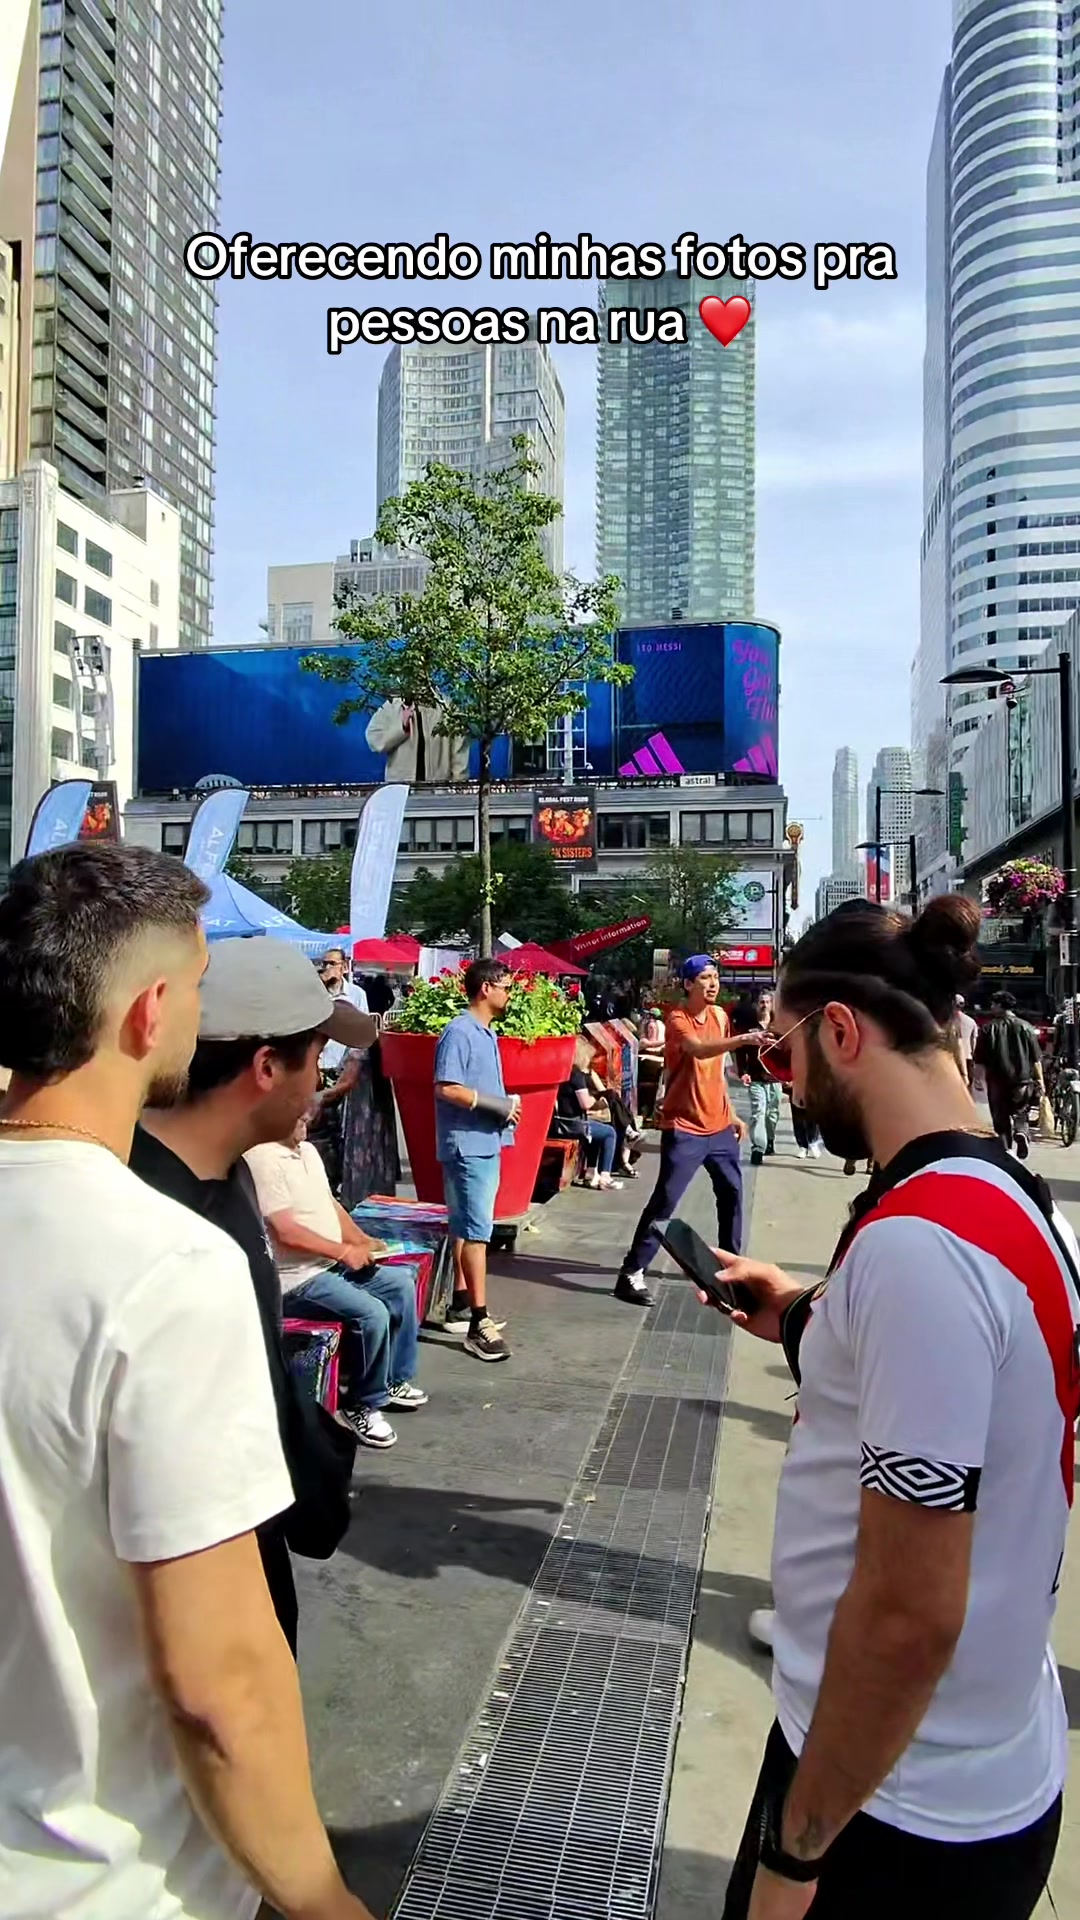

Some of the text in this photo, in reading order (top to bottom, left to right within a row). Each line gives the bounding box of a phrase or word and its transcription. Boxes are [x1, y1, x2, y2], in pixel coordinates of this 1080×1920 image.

[656, 642, 682, 651] MESSI
[684, 776, 711, 785] astral
[562, 847, 593, 858] SISTERS
[574, 937, 600, 952] Visitor
